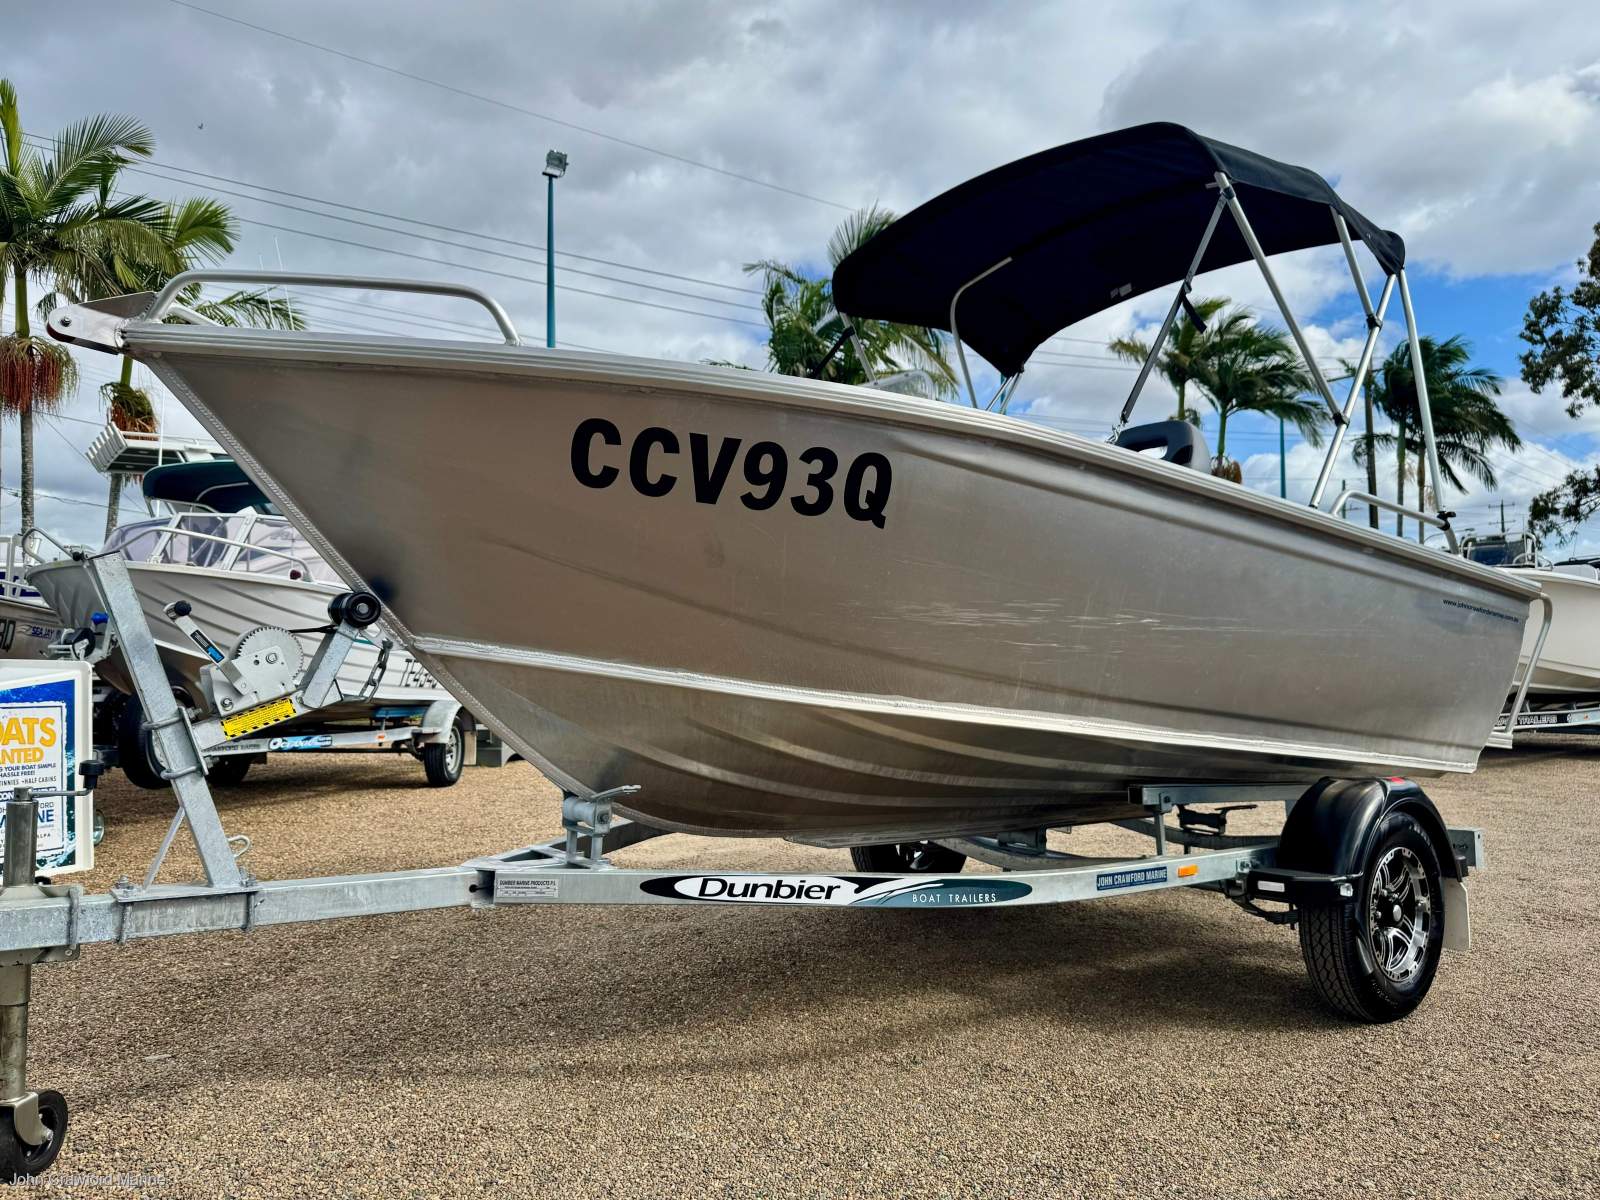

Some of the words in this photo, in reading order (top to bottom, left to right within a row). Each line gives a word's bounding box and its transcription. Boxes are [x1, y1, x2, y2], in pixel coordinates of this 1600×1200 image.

[570, 417, 892, 529] CCV93Q
[0, 717, 57, 747] ATS
[0, 748, 44, 765] NTED
[1097, 876, 1113, 887] JOHN
[1114, 871, 1145, 885] CRAWFORD
[1146, 868, 1167, 881] MARINE
[698, 877, 841, 899] Dunbier
[912, 893, 941, 903] BOAT
[948, 893, 997, 903] TRAILERS
